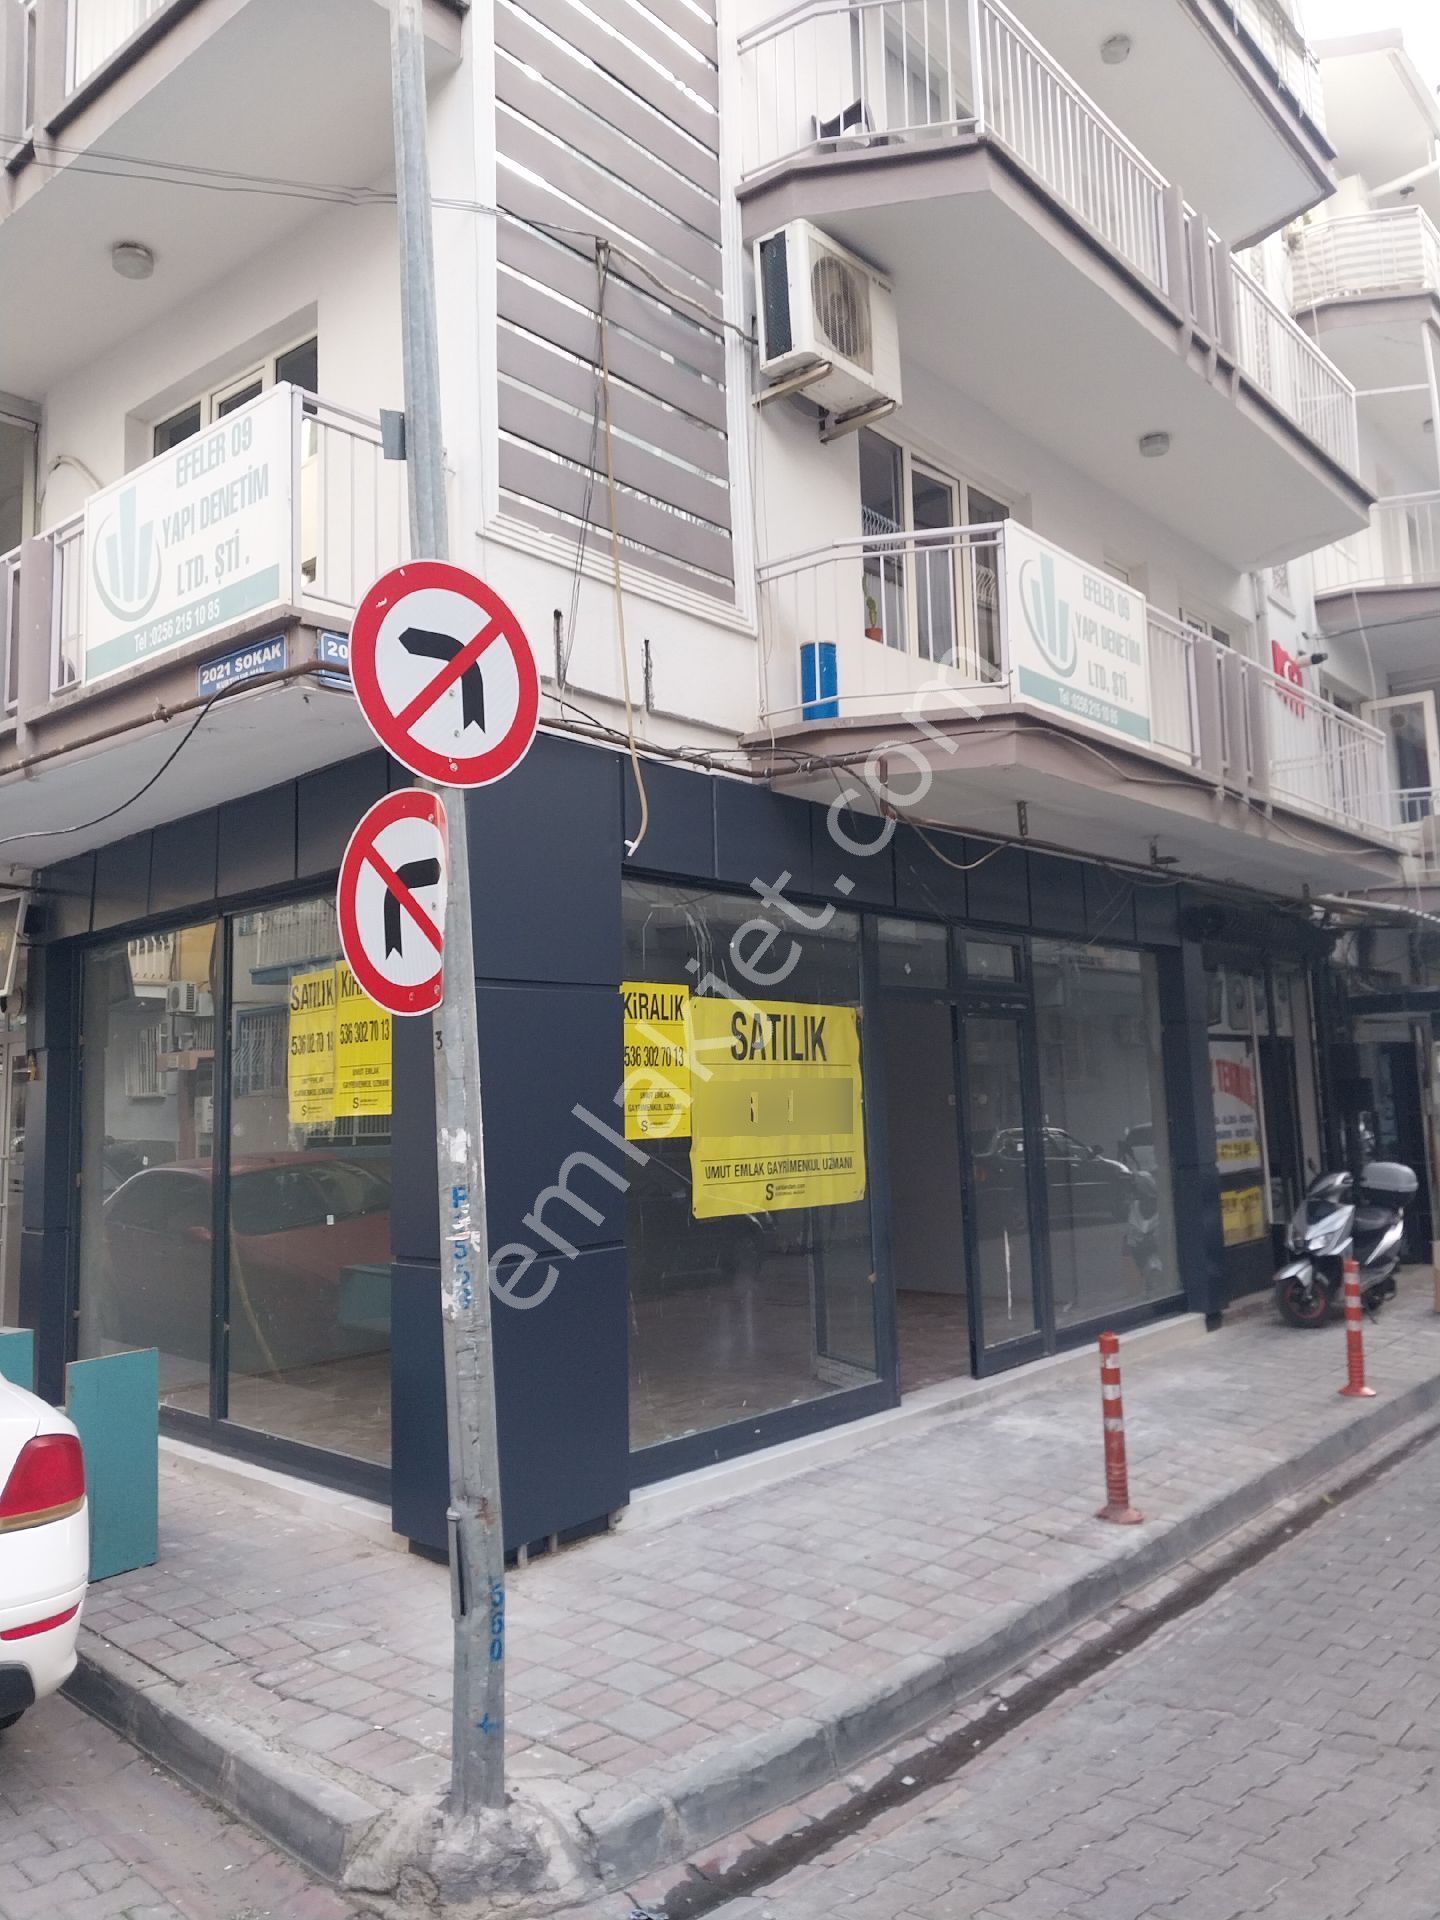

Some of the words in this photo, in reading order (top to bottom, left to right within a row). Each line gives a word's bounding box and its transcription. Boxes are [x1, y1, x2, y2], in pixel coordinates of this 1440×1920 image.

[176, 432, 226, 488] EFELER
[232, 416, 252, 456] 09
[163, 504, 194, 548] YAPI
[200, 464, 268, 530] DENETİM
[178, 554, 208, 596] LTD.
[134, 632, 147, 652] Tel
[176, 609, 192, 635] 215
[195, 604, 206, 626] 10
[208, 598, 220, 620] 85
[1075, 611, 1098, 647] YAPI
[202, 662, 231, 685] 2021
[234, 643, 282, 672] SOKAK
[290, 978, 334, 1010] SATILIK
[340, 1023, 352, 1044] 536
[354, 1021, 368, 1042] 302
[370, 1020, 378, 1041] 70
[381, 1018, 390, 1040] 13
[730, 1011, 828, 1062] SATILIK
[624, 1046, 641, 1067] 536
[643, 1046, 659, 1067] 302
[661, 1046, 672, 1067] 70
[674, 1046, 684, 1067] 13
[705, 1165, 732, 1179] UMUT
[734, 1162, 764, 1178] EMLAK
[822, 1156, 853, 1170] UZMANI
